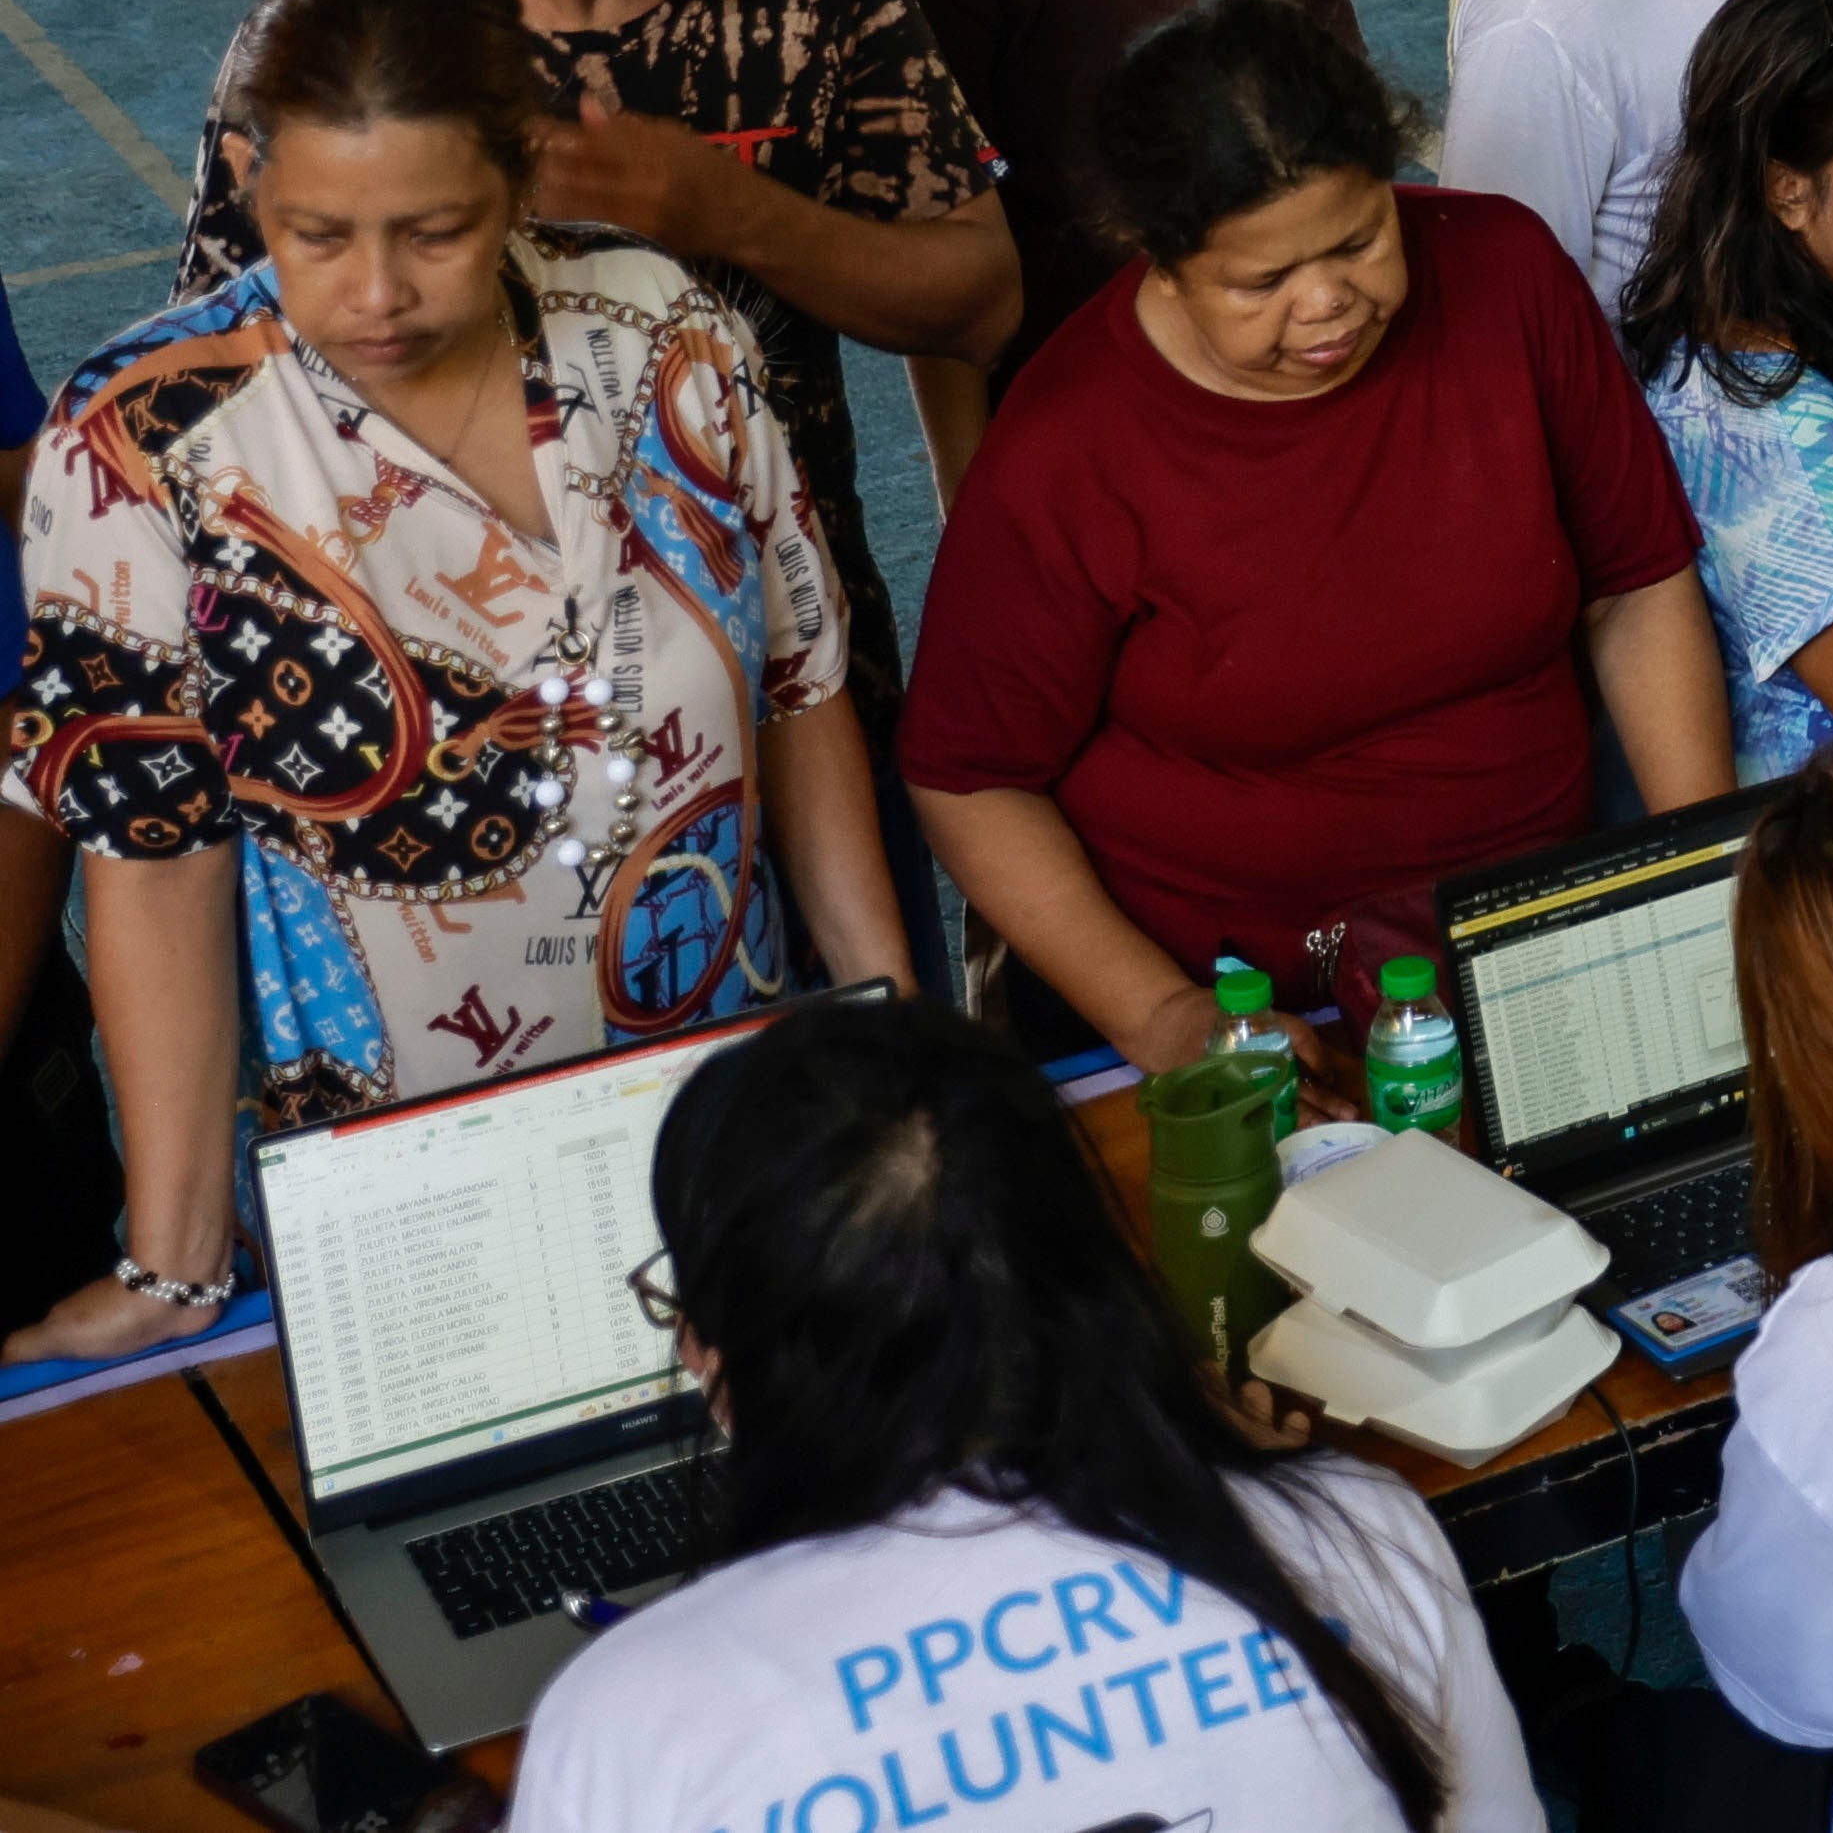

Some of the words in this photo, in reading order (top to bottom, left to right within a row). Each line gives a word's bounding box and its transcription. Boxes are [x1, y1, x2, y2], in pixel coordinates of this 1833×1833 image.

[585, 327, 624, 412] VUITTON
[774, 533, 811, 588] LOUIS
[404, 575, 451, 620] Louis
[612, 583, 641, 660] VUITTON
[789, 585, 823, 643] VUITTON
[611, 660, 643, 714] LOUIS
[524, 935, 576, 966] LOUIS
[438, 1197, 482, 1216] ENJAMBRE
[402, 1223, 442, 1240] MICHELLE
[447, 1209, 492, 1228] ENJAMBRE
[404, 1237, 442, 1254] NICHOLE
[407, 1251, 447, 1268] SHERWIN
[409, 1268, 438, 1282] SUSAN
[411, 1283, 437, 1296] VILMA
[439, 1271, 478, 1288] ZULUETA
[409, 1310, 443, 1326] ANGELA
[446, 1302, 472, 1316] MARIE
[475, 1292, 508, 1308] CALLAO
[413, 1293, 450, 1310] VIRGINIA
[453, 1282, 492, 1299] ZULUETA
[413, 1337, 449, 1354] GILBERT
[453, 1324, 498, 1343] GONZALES
[417, 1354, 444, 1368] JAMES
[420, 1381, 450, 1396] NANCY
[452, 1371, 486, 1387] CALLAO
[422, 1394, 456, 1410] ANGELA
[423, 1406, 464, 1424] GENALYN
[468, 1396, 500, 1412] TIVIDAD
[621, 1413, 658, 1431] HUAWEI
[833, 1560, 1185, 1734] PPCRV
